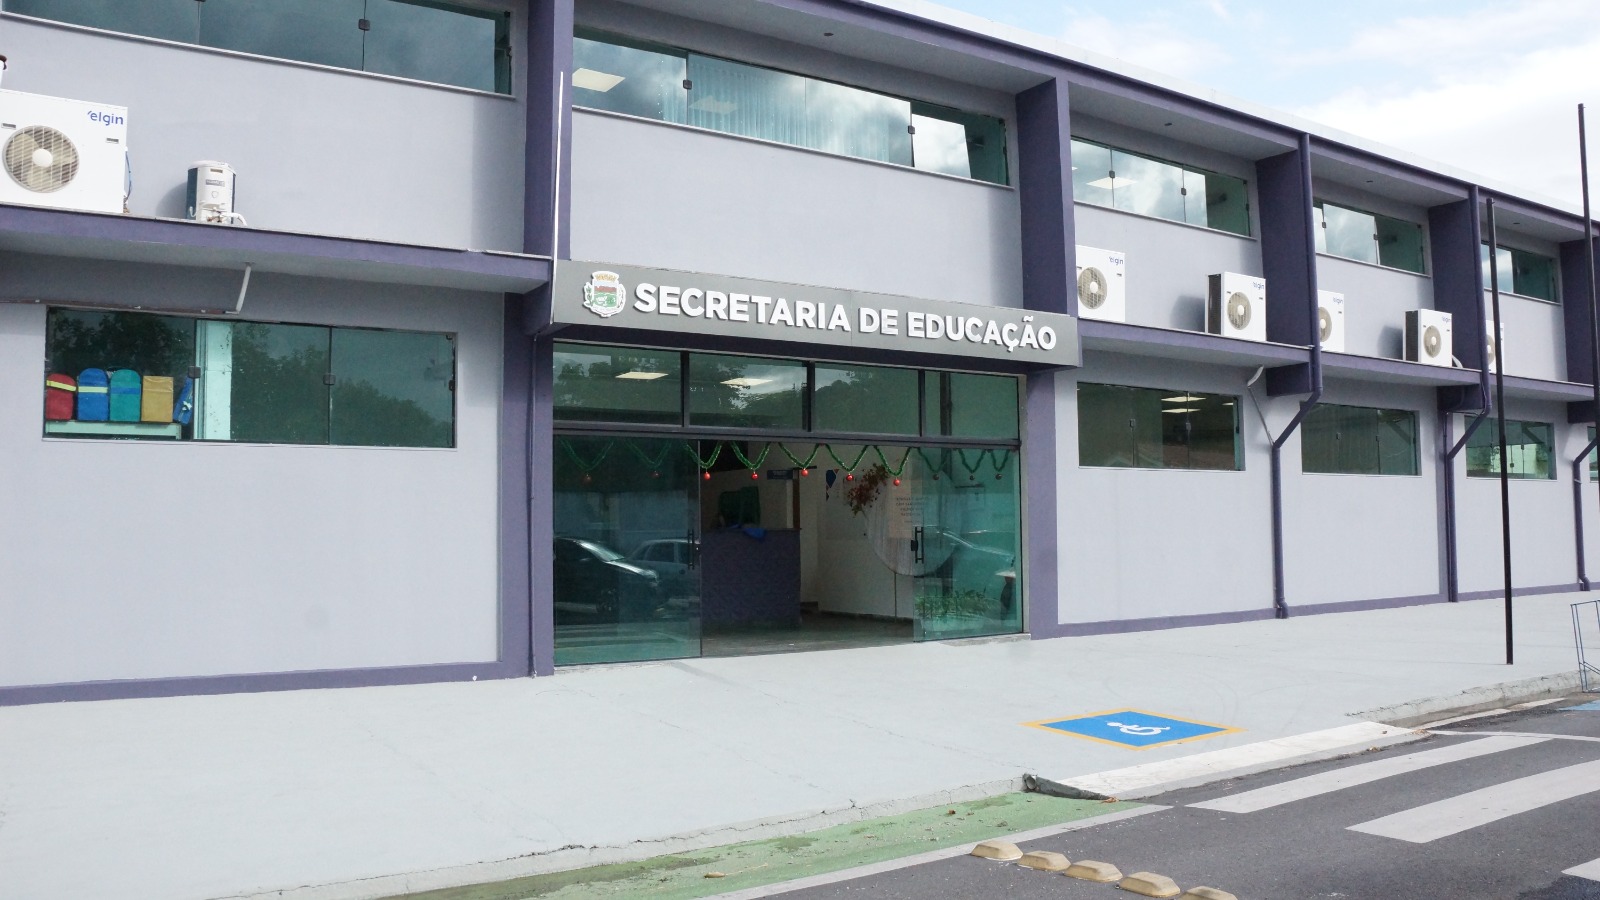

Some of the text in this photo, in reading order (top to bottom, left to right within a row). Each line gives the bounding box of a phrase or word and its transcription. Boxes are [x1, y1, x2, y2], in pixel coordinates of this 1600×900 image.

[634, 283, 1057, 352] SECRETARIA DE EDUCAÇÃO
